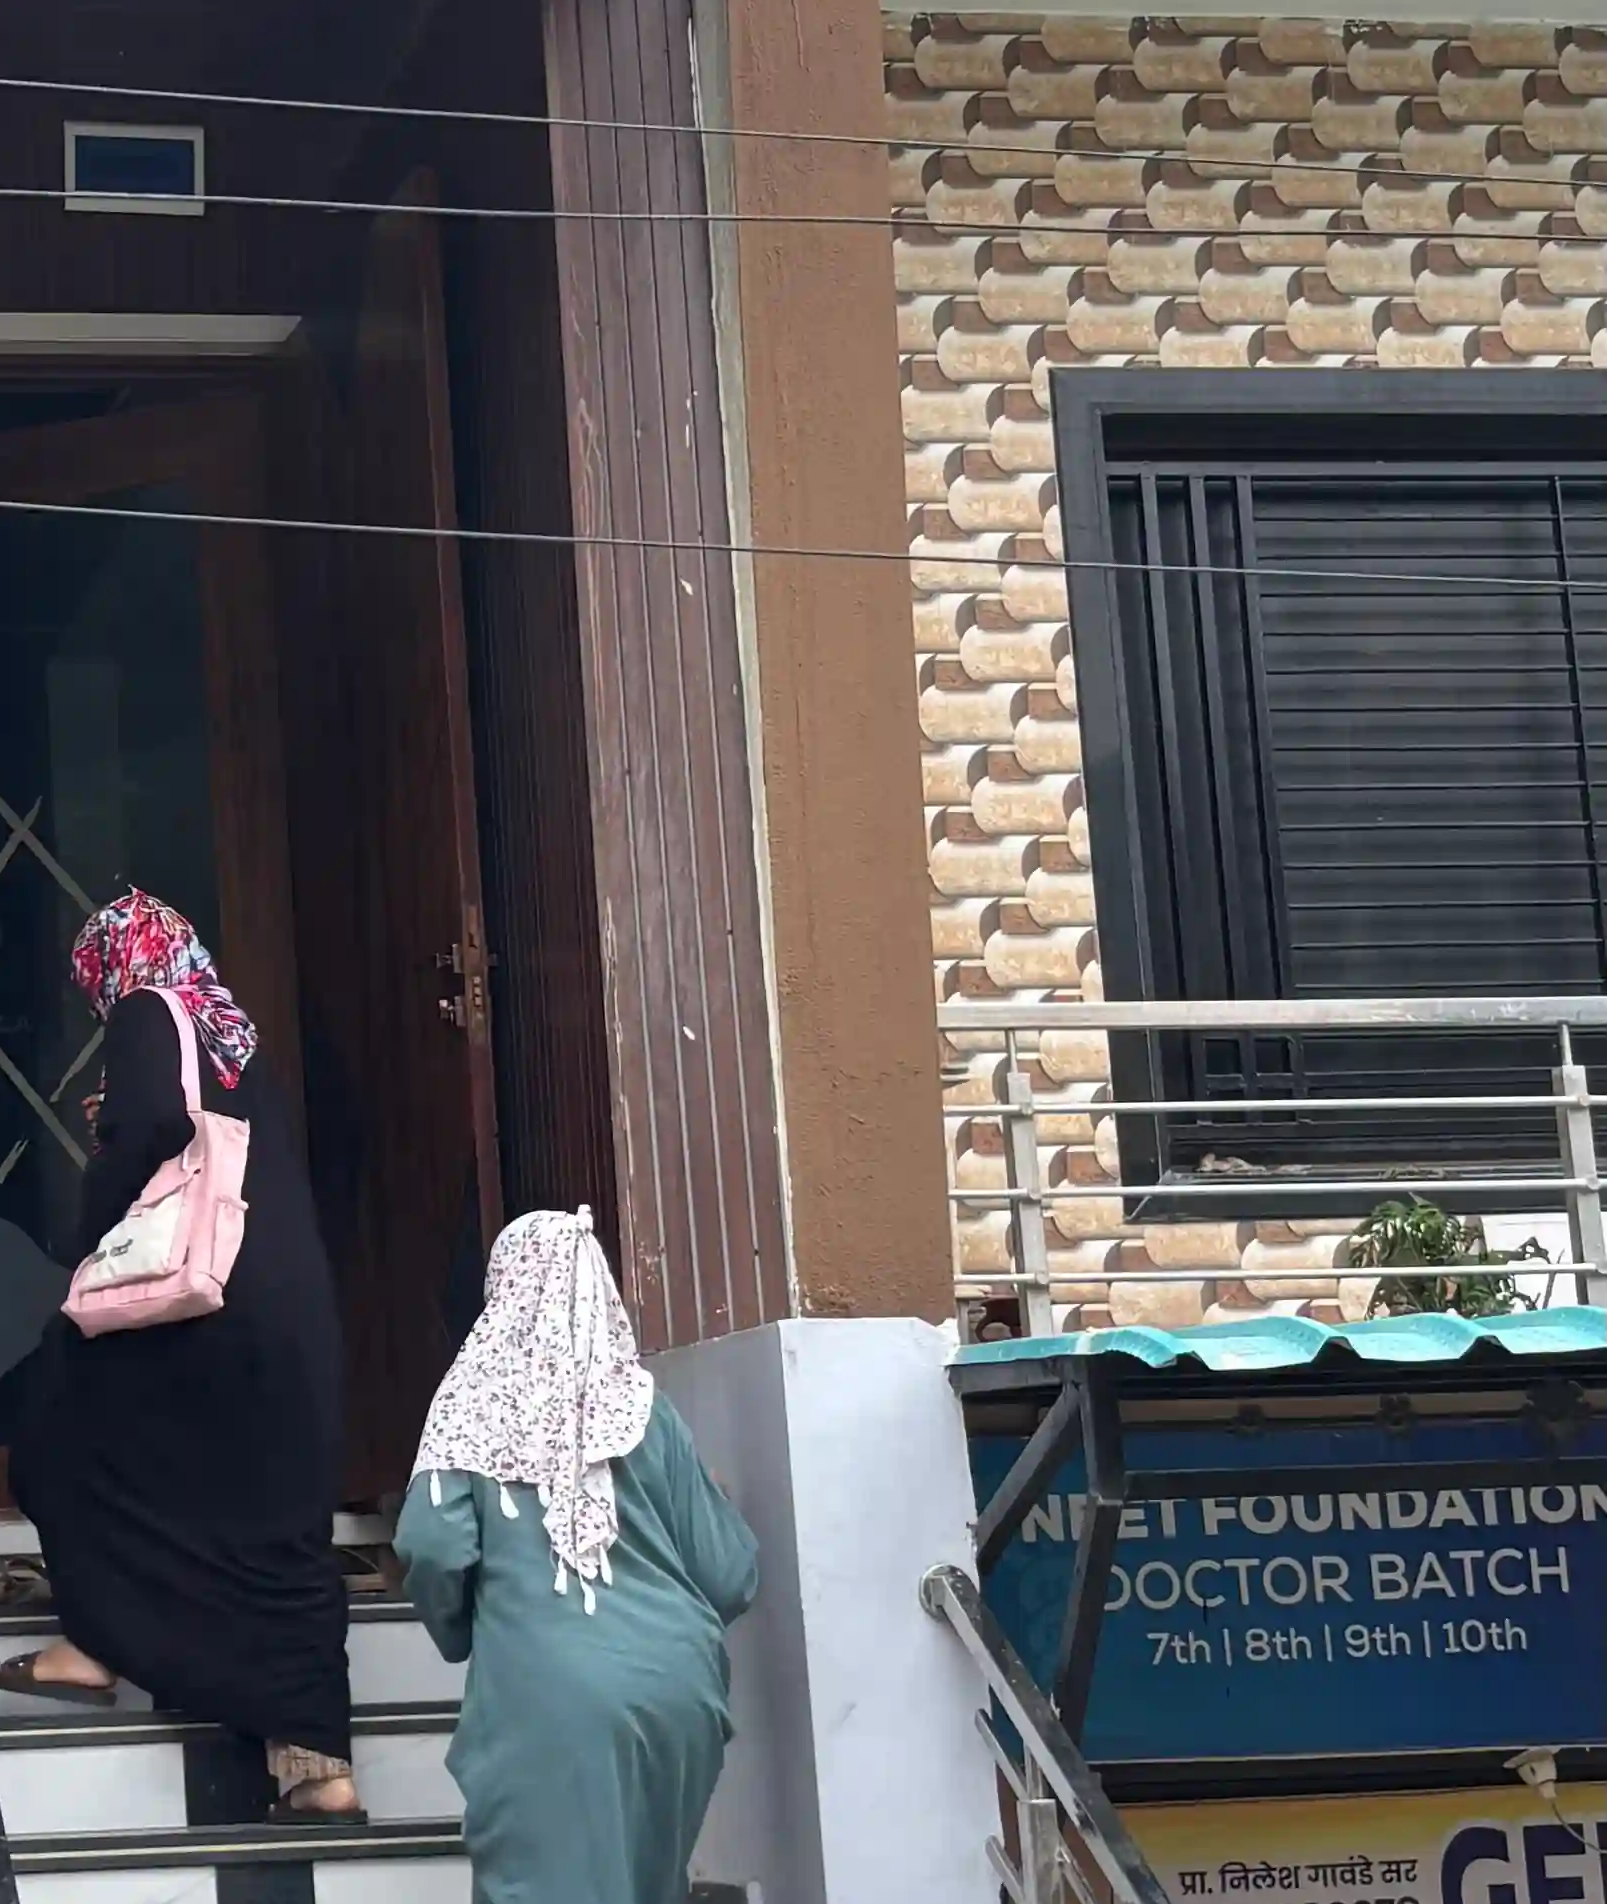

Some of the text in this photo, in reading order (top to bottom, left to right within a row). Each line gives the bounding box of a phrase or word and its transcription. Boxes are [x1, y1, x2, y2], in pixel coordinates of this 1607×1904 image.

[1369, 1547, 1571, 1601] BATCH
[1146, 1629, 1212, 1666] 7th
[1244, 1626, 1313, 1663] 8th
[1344, 1622, 1412, 1659] 9th
[1442, 1617, 1528, 1654] 10th
[1178, 1854, 1418, 1896] प्रा. निलेश गावंडे सर
